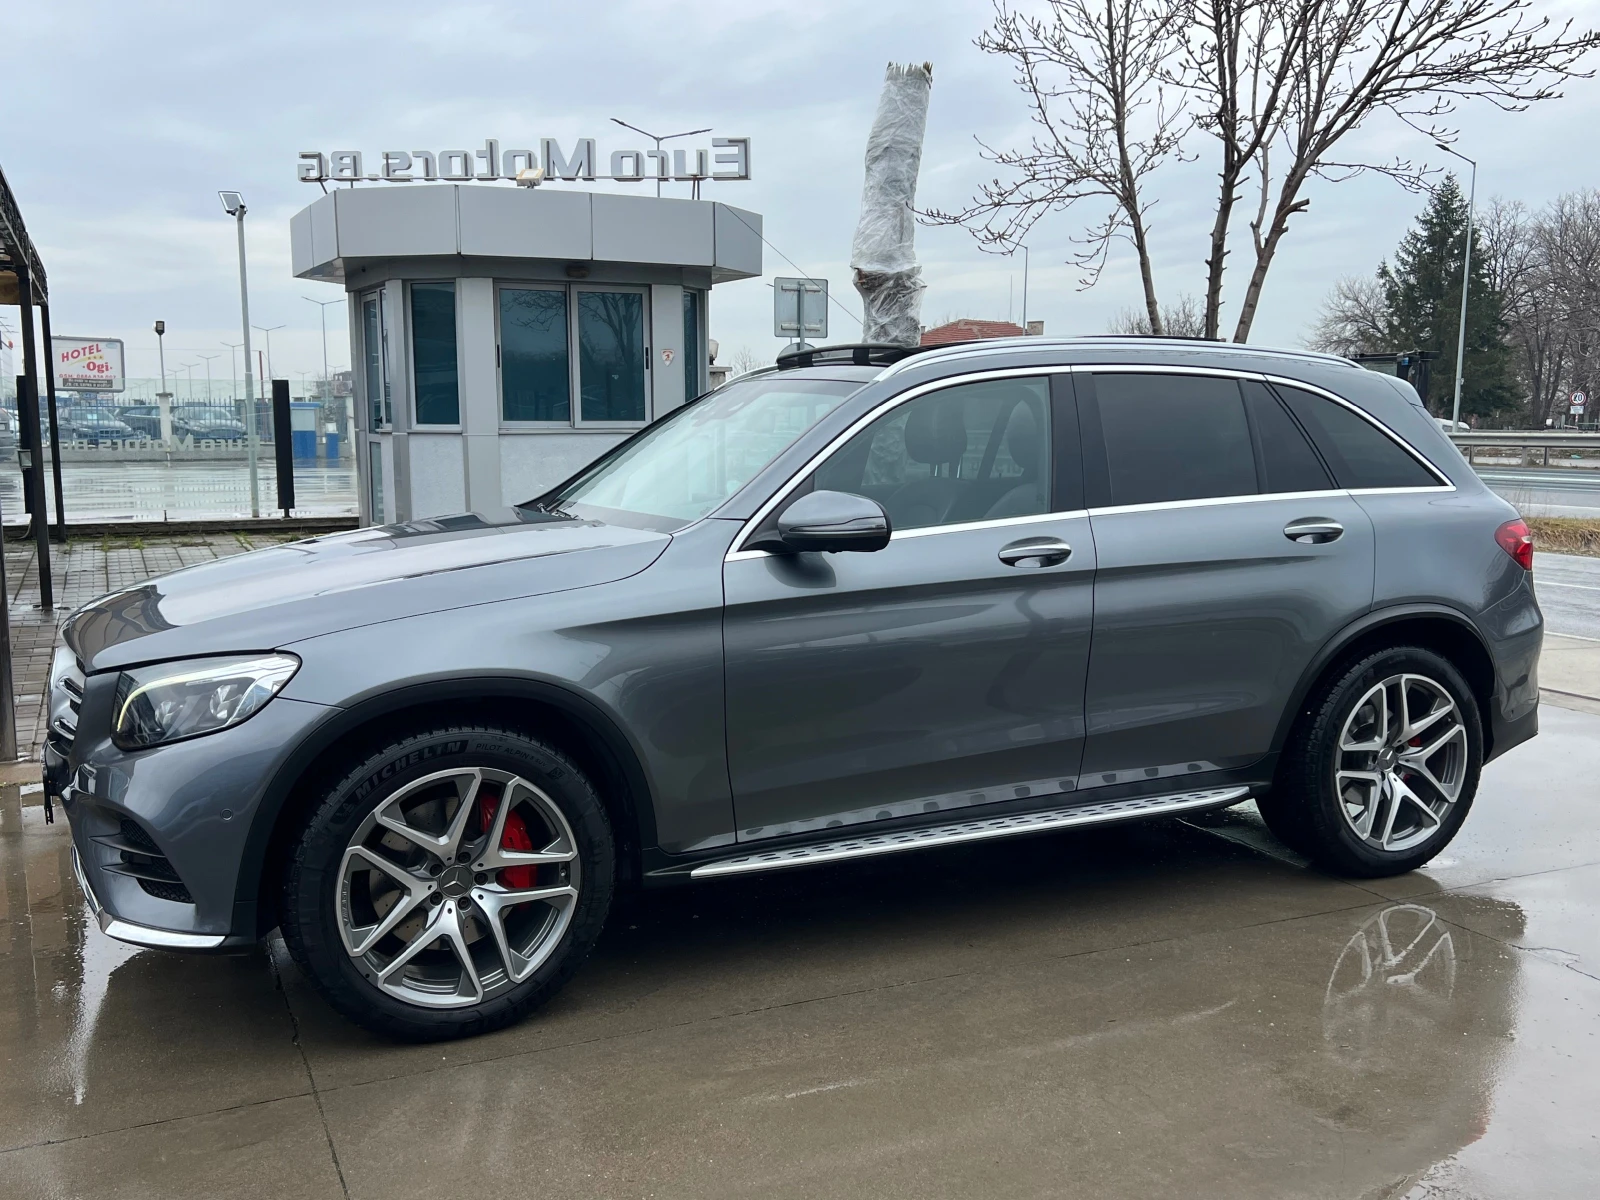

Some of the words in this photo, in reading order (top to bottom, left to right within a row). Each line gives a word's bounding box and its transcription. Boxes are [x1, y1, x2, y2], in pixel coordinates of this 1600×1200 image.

[61, 343, 102, 362] HOTEL
[86, 361, 109, 373] Ogi
[475, 743, 503, 751] PILOT
[504, 747, 529, 760] ALPIN
[355, 741, 461, 800] MICHELIN
